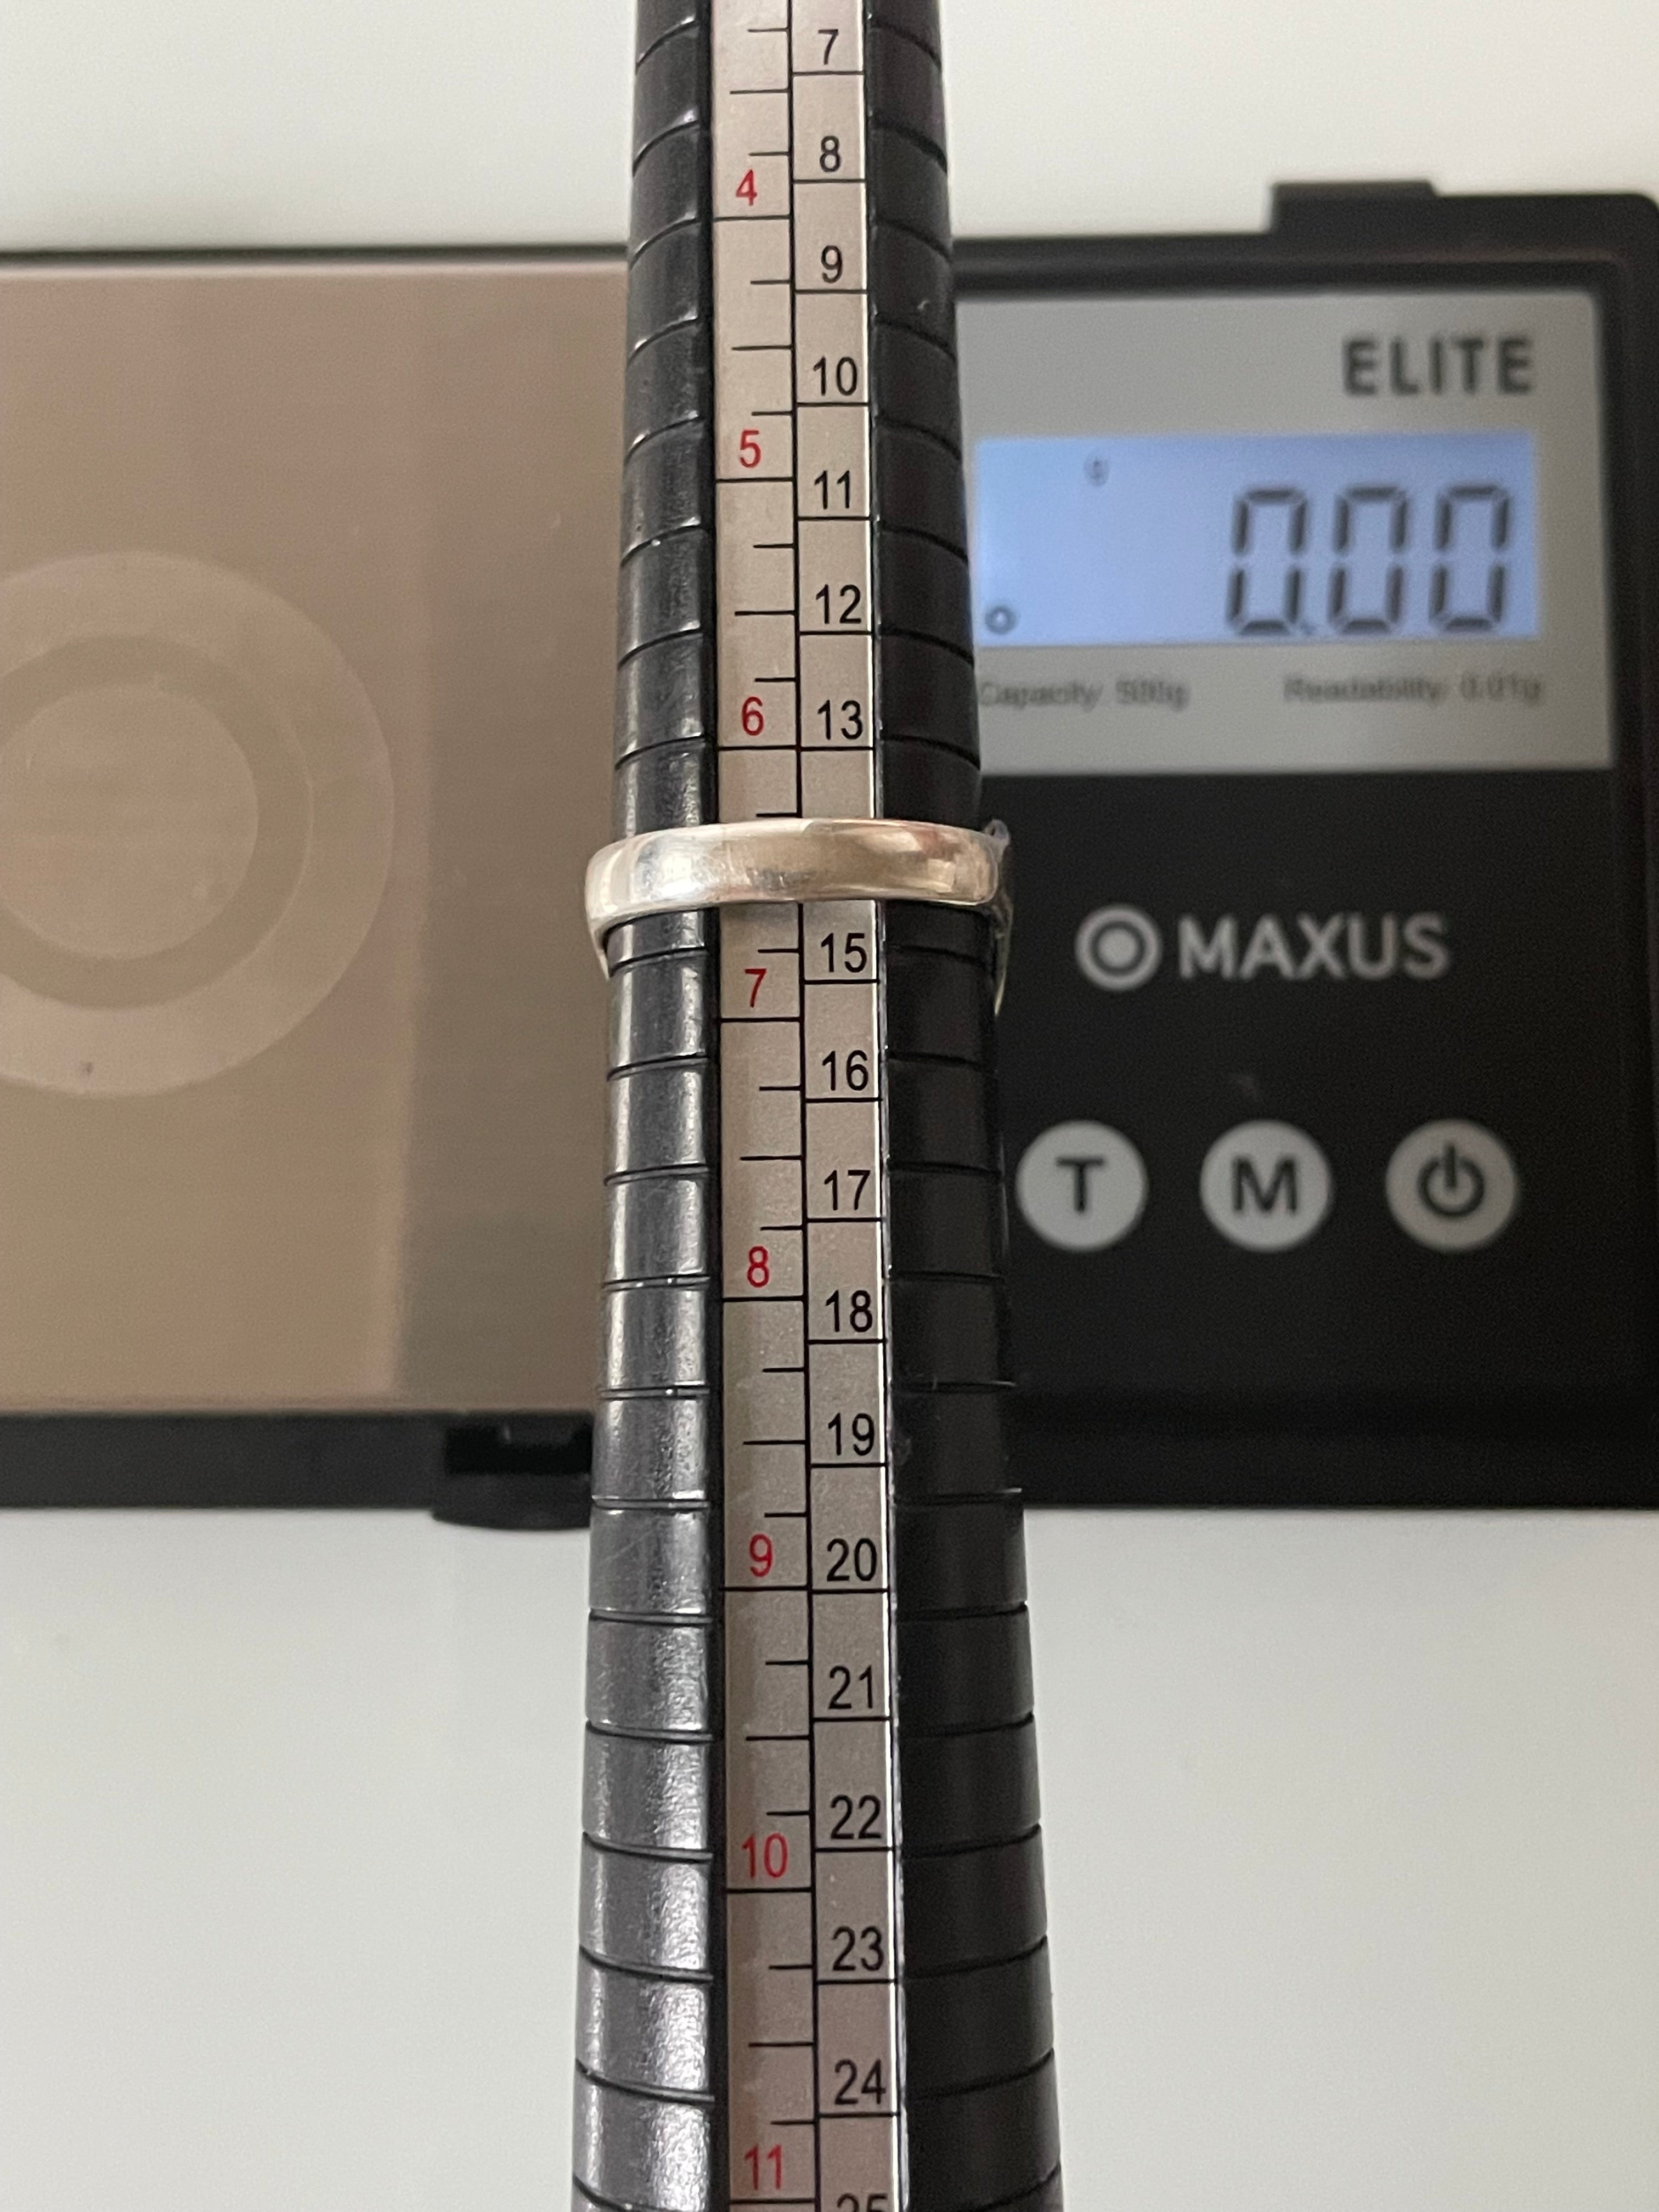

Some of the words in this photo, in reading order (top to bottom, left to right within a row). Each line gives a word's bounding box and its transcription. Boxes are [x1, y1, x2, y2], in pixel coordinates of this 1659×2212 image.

[818, 29, 839, 65] 7
[819, 136, 841, 172] 8
[736, 169, 758, 205] 4
[821, 245, 843, 284] 9
[813, 357, 857, 396] 10
[1342, 334, 1533, 396] ELITE
[740, 428, 762, 469] 5
[814, 470, 850, 510] 11
[816, 584, 862, 624] 12
[741, 695, 764, 736] 6
[817, 699, 863, 740] 13
[821, 933, 867, 973] 15
[1177, 913, 1451, 981] MAXUS
[746, 967, 768, 1006] 7
[822, 1049, 869, 1091] 16
[824, 1169, 871, 1211] 17
[1056, 1156, 1104, 1214] T
[1231, 1155, 1299, 1216] M
[747, 1246, 770, 1288] 8
[825, 1289, 873, 1333] 18
[828, 1413, 875, 1456] 19
[749, 1534, 774, 1577] 9
[826, 1538, 877, 1582] 20
[828, 1666, 873, 1710] 21
[830, 1795, 882, 1840] 22
[743, 1833, 788, 1879] 10
[832, 1926, 884, 1972] 23
[834, 2059, 886, 2106] 24
[746, 2145, 782, 2187] 11
